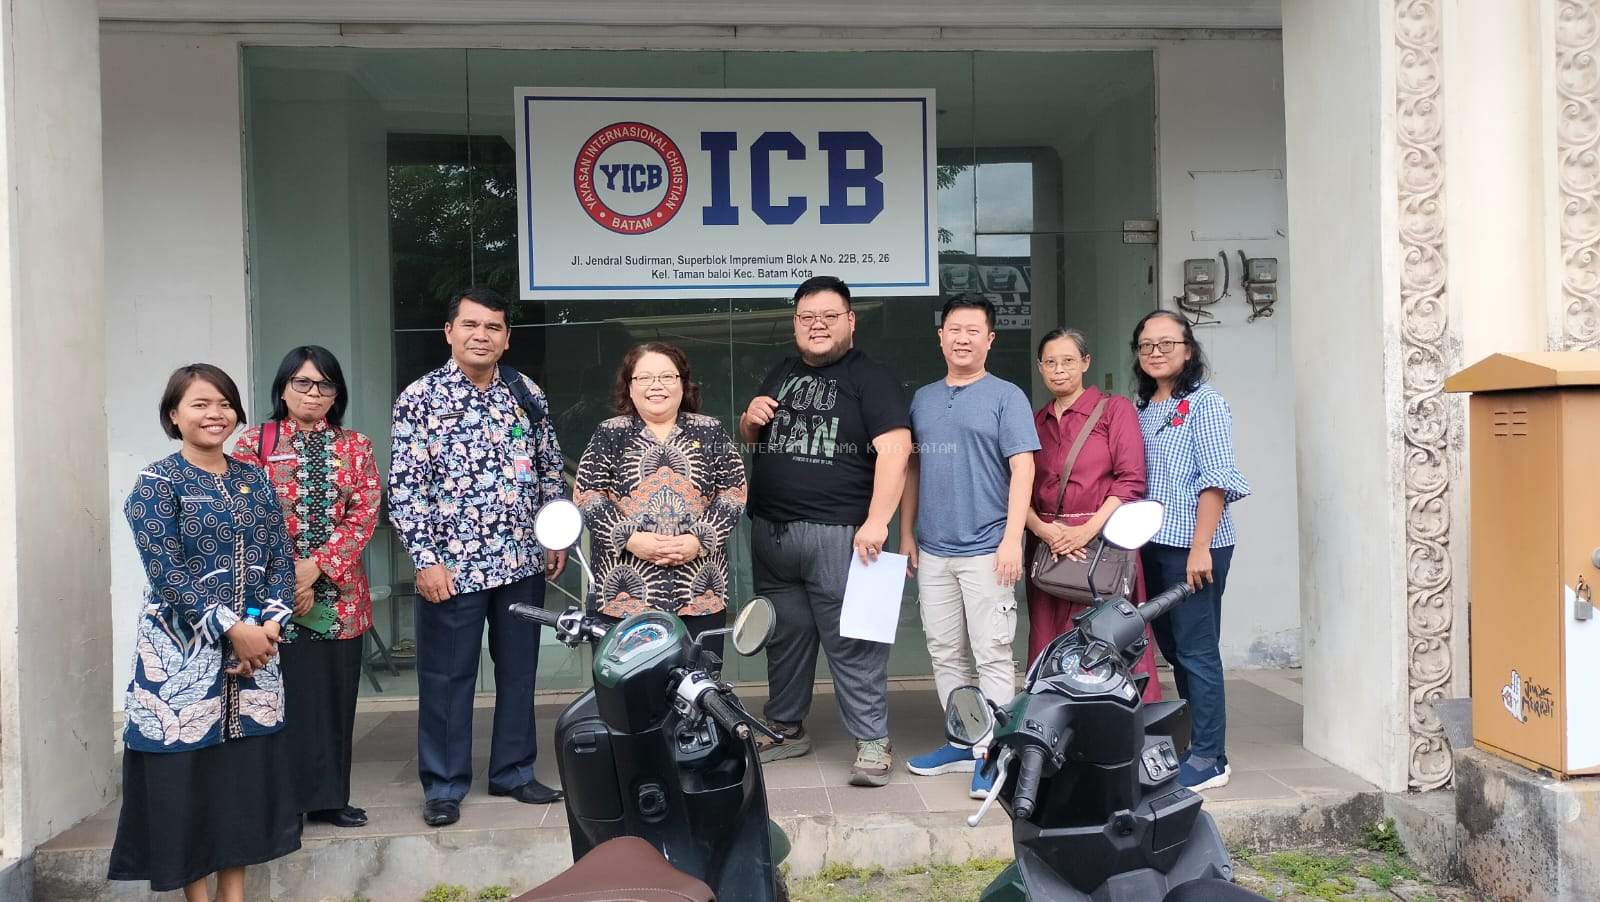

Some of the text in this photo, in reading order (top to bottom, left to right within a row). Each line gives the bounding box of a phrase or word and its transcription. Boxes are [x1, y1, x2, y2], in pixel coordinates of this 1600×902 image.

[579, 126, 682, 210] YAYASAN INTERNASIONAL CHRISTIAN
[599, 163, 663, 193] YICB
[700, 131, 885, 226] ICB
[611, 217, 653, 231] BATAM
[571, 255, 583, 266] Jl.
[585, 255, 622, 266] Jendral
[625, 255, 675, 266] Sudirman,
[677, 254, 728, 267] Superblok
[729, 254, 784, 266] Impremium
[786, 254, 808, 264] Blok
[810, 254, 818, 264] A
[820, 254, 836, 264] No.
[862, 253, 876, 264] 25,
[878, 253, 890, 263] 26
[651, 268, 813, 279] Kel. Taman baloi Kec. Batam Kota
[777, 374, 837, 411] YOU
[768, 409, 840, 458] CAN
